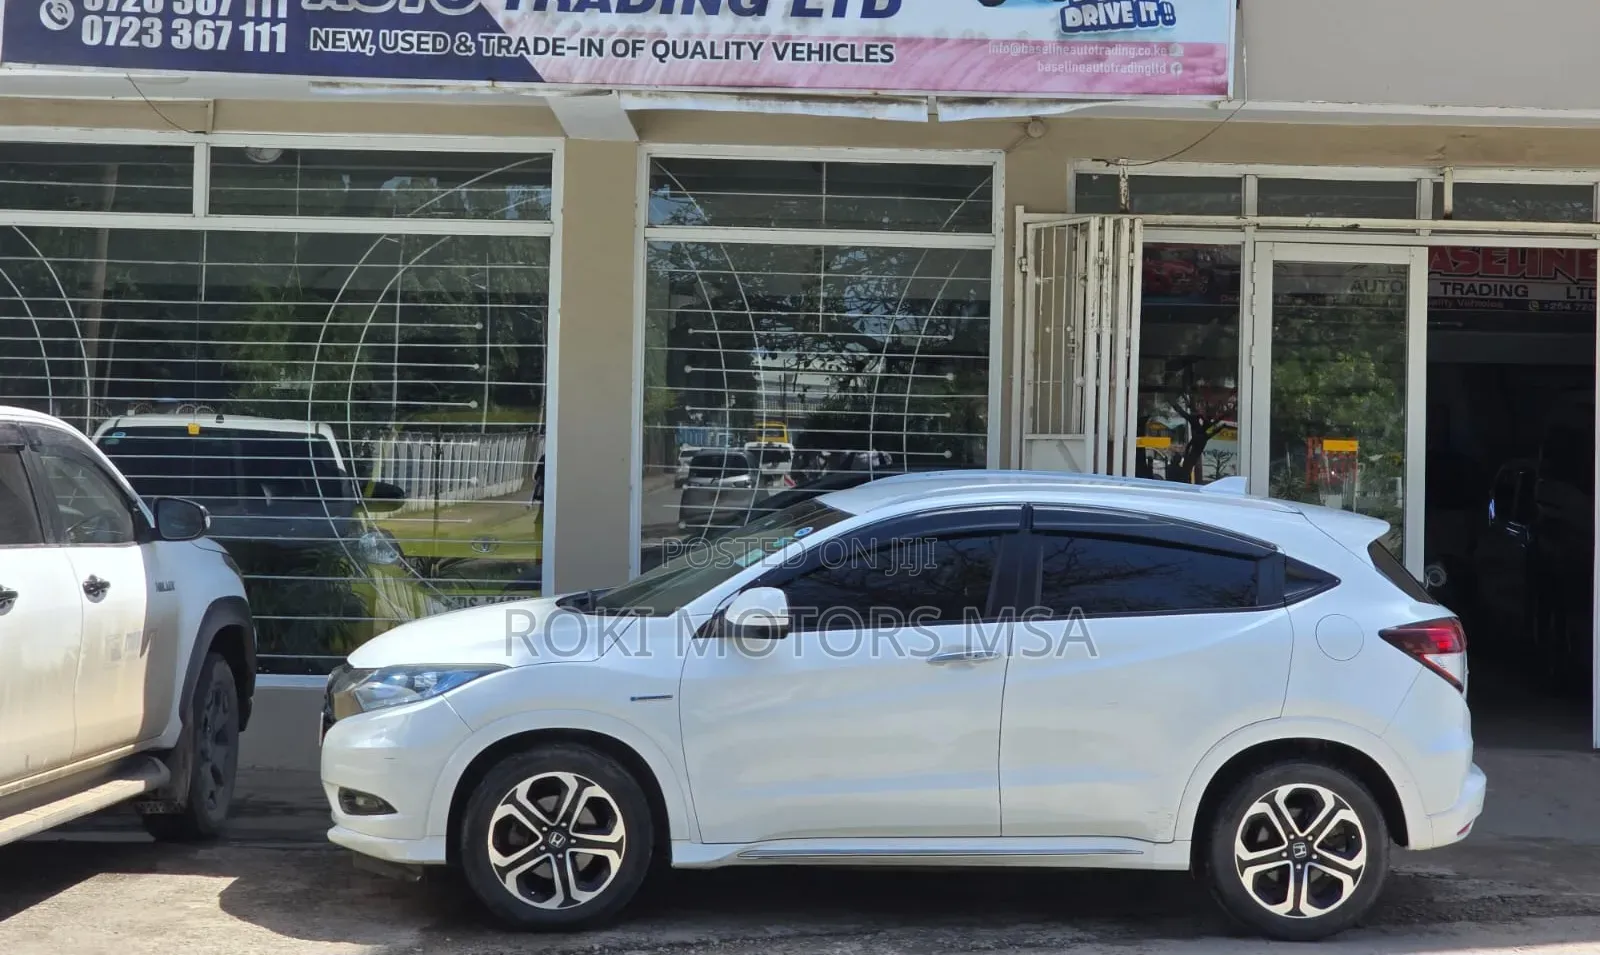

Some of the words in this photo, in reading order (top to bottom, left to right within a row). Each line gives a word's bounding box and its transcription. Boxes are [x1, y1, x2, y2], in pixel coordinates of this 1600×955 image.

[1064, 1, 1134, 27] DRIVE
[1139, 1, 1158, 22] IT
[81, 15, 163, 48] 0723
[171, 18, 232, 50] 367
[239, 21, 287, 53] 111
[310, 29, 376, 55] NEW,
[381, 30, 449, 54] USED
[454, 32, 476, 55] &
[611, 38, 645, 59] OF
[652, 38, 764, 62] QUALITY
[772, 41, 895, 63] VEHICLES
[1440, 282, 1529, 298] TRADING
